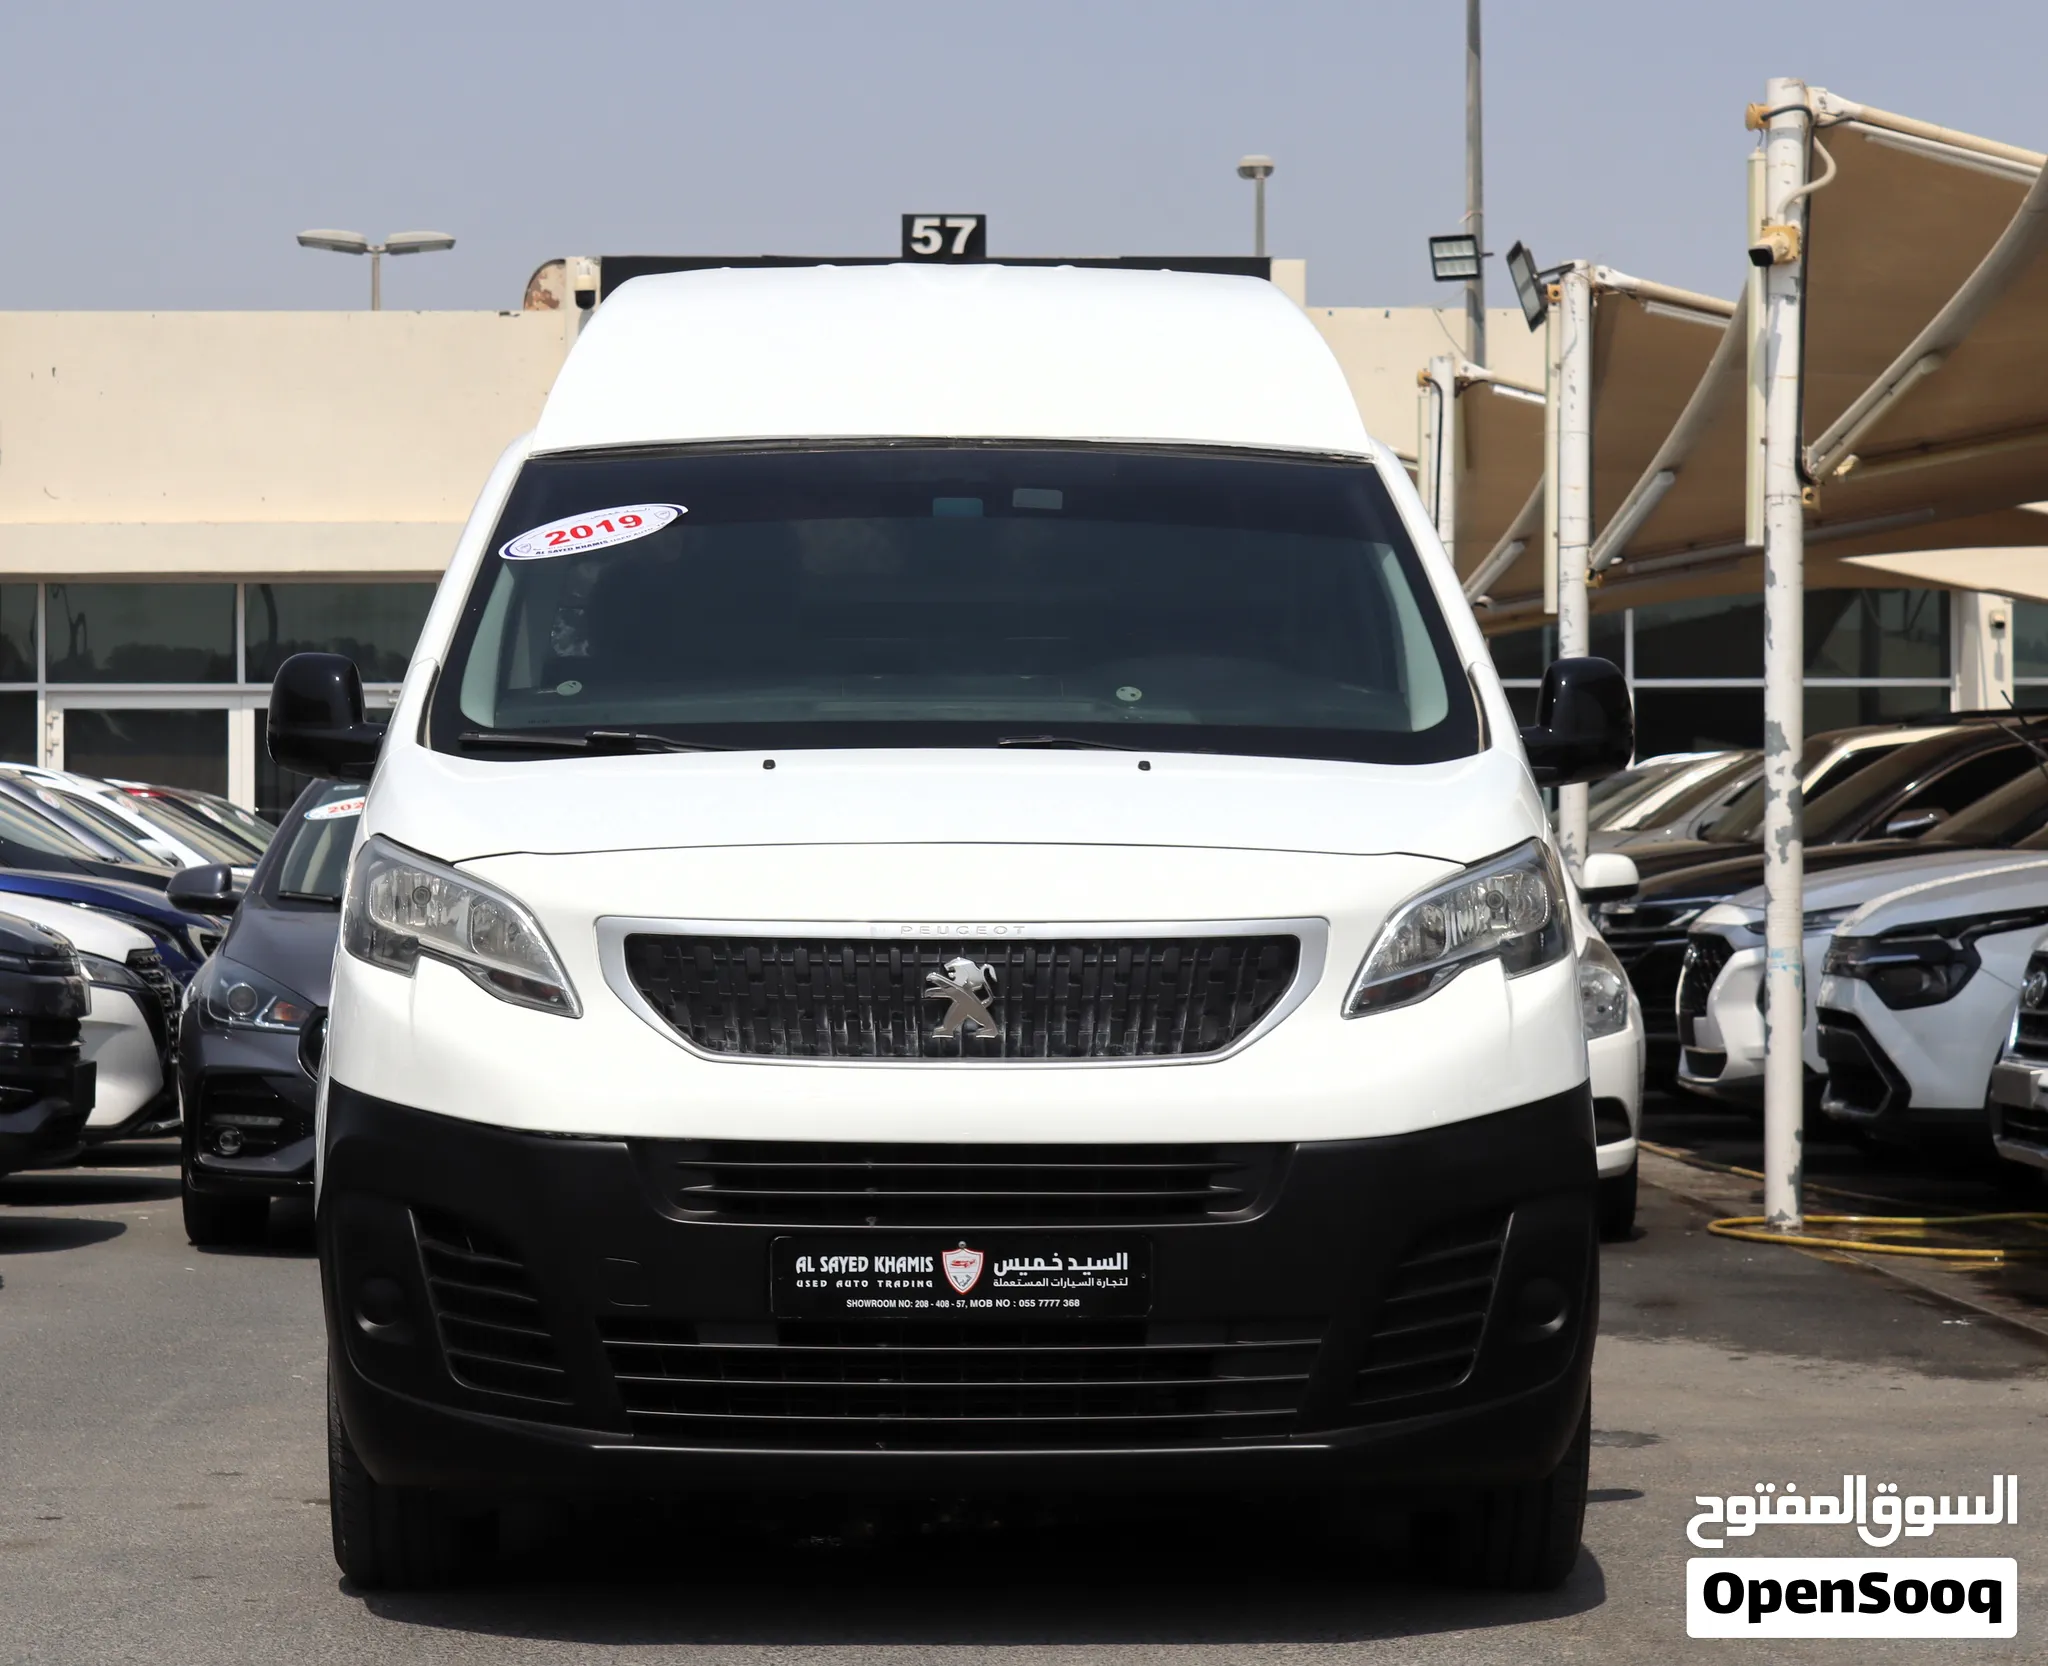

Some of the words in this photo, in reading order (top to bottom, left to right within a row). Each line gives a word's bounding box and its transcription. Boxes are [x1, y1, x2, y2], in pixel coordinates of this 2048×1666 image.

[910, 217, 978, 255] 57
[544, 514, 643, 547] 2019
[328, 801, 365, 813] 202
[900, 925, 1025, 935] PEUGEOT
[795, 1256, 816, 1274] AL
[819, 1256, 869, 1274] SAYED
[874, 1256, 934, 1274] KHAMIS
[993, 1252, 1063, 1277] خميس
[1067, 1252, 1128, 1276] السيد
[796, 1279, 828, 1288] USED
[836, 1279, 869, 1288] AUTO
[877, 1279, 934, 1289] TRADING
[993, 1277, 1049, 1288] المستعملة
[1050, 1277, 1094, 1289] السيارات
[1096, 1277, 1129, 1289] لتجارة
[846, 1299, 897, 1308] SHOWROOM
[898, 1299, 913, 1308] NO:
[914, 1299, 929, 1308] 208
[935, 1299, 949, 1308] 408
[970, 1299, 993, 1308] MOB
[995, 1299, 1010, 1308] NO
[1018, 1299, 1036, 1308] 055
[1038, 1299, 1060, 1308] 7777
[1063, 1299, 1080, 1308] 368
